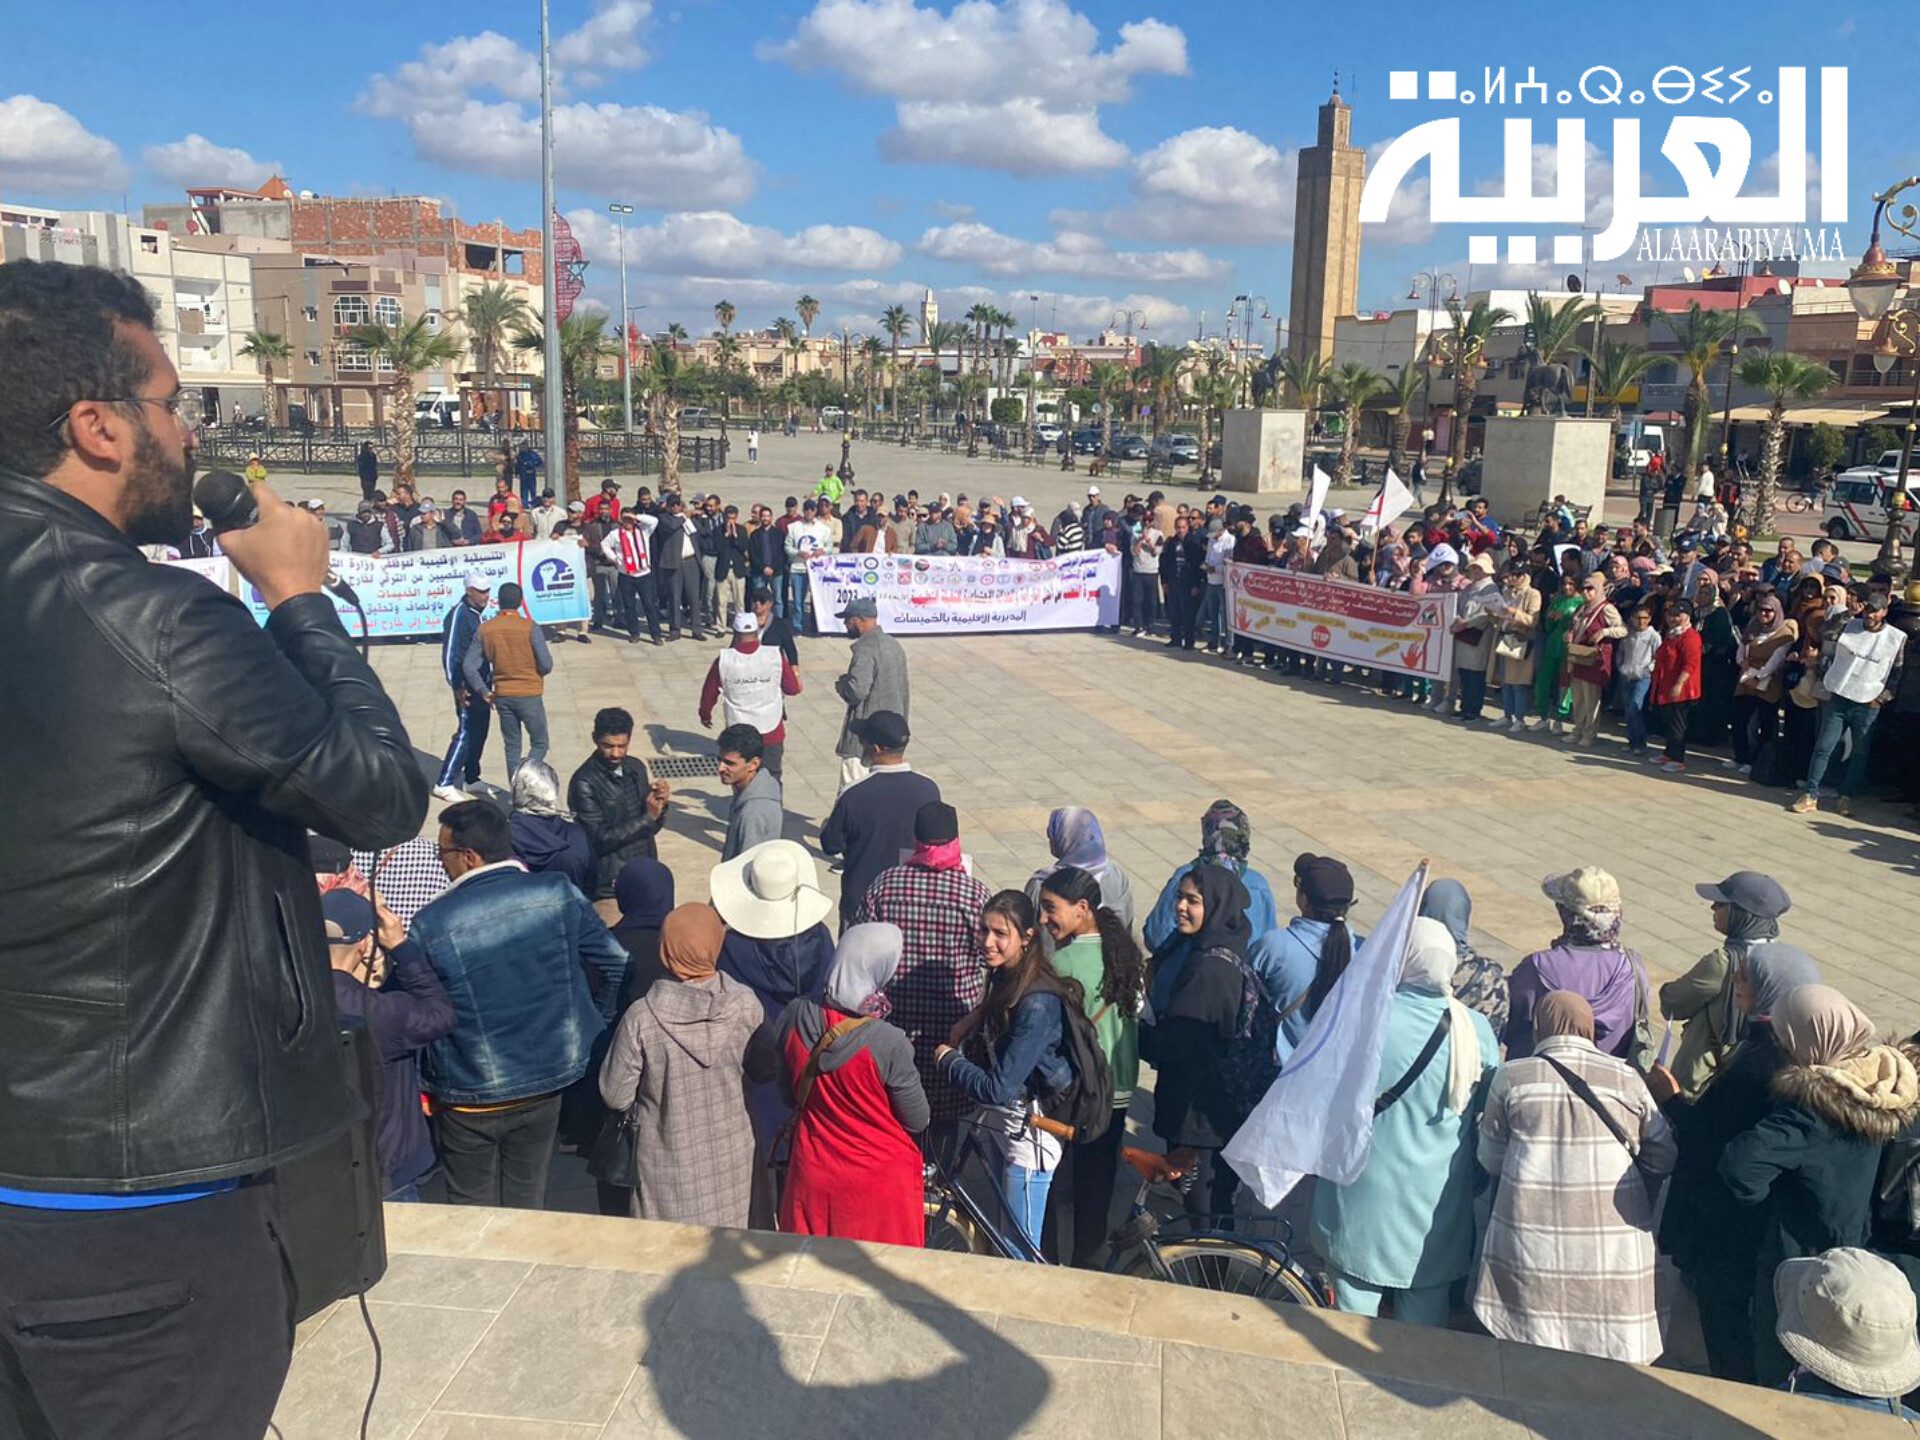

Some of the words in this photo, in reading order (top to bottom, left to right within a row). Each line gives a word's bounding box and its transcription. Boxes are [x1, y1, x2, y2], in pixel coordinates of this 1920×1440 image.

[464, 551, 506, 566] التنسيقية
[894, 612, 949, 625] بالخميسات
[991, 609, 1027, 623] المديرية
